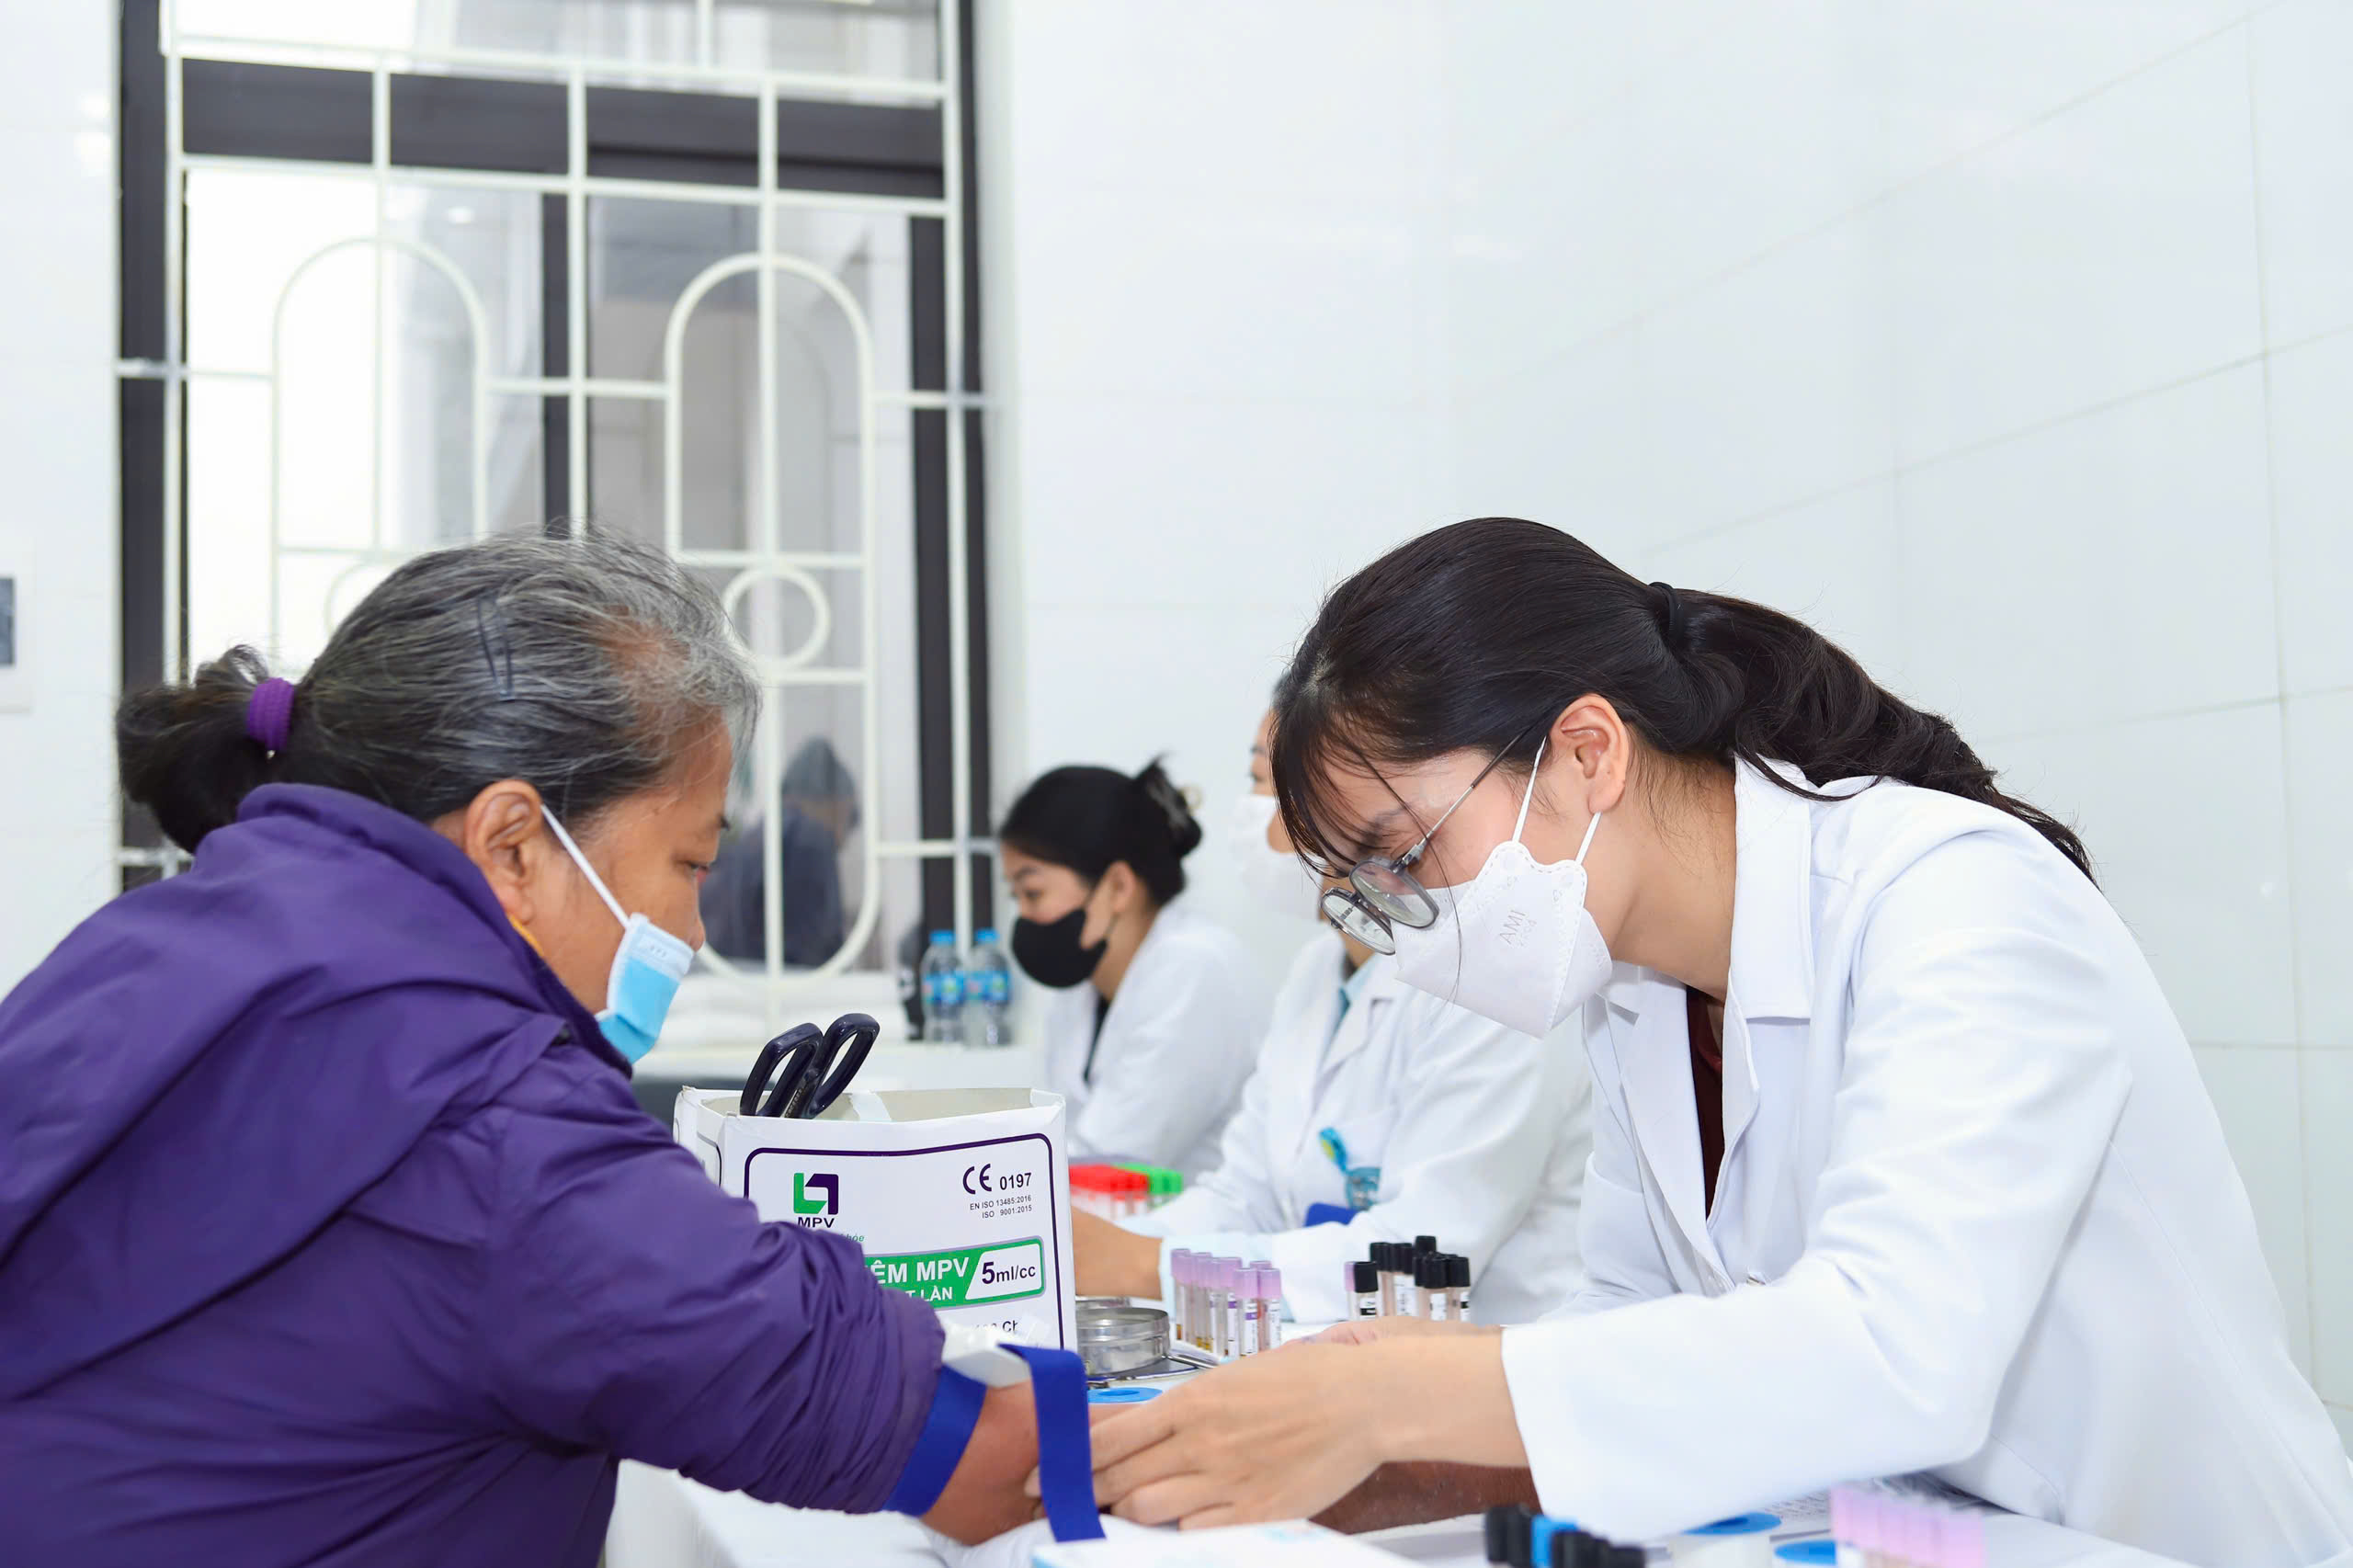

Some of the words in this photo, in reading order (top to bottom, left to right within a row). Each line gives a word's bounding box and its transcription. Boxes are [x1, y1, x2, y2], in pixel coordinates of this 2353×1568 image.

[999, 1172, 1031, 1190] 0197
[970, 1202, 980, 1210] EN
[982, 1200, 995, 1209] ISO
[996, 1195, 1031, 1207] 13485:2016
[982, 1210, 995, 1219] ISO
[1000, 1204, 1032, 1216] 9001:2015
[797, 1216, 835, 1229] MPV
[916, 1256, 970, 1282] MPV
[982, 1261, 1036, 1285] 5ml/cc
